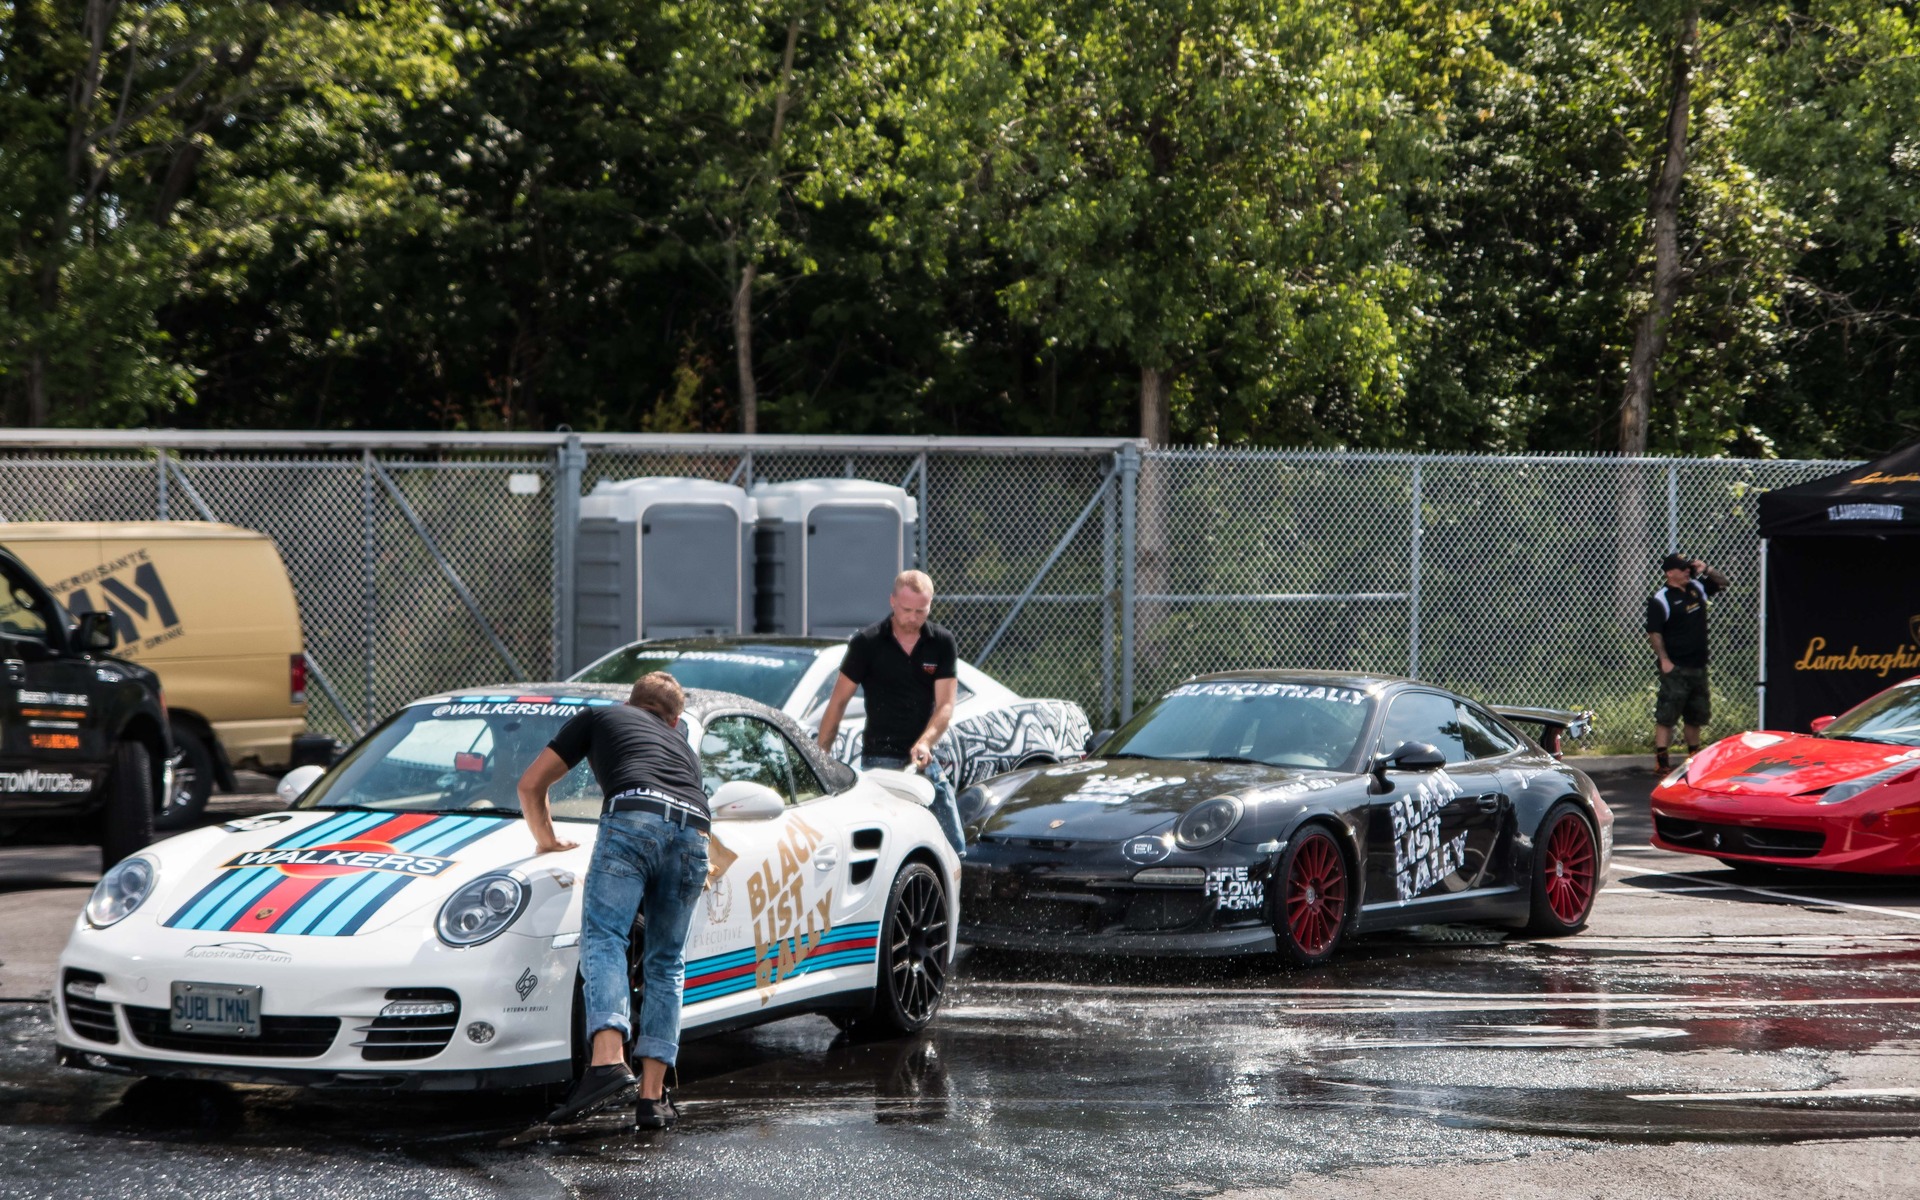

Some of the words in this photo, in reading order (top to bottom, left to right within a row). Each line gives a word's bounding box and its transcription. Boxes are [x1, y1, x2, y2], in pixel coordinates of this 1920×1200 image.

[1389, 768, 1464, 840] BLACK
[238, 850, 443, 875] WALKERS
[747, 812, 824, 921] BLACK
[1395, 814, 1441, 874] LIST
[1396, 829, 1468, 907] RALLY
[754, 874, 804, 964] LIST
[756, 888, 833, 1006] RALLY
[174, 995, 256, 1024] SUBLIMNL
